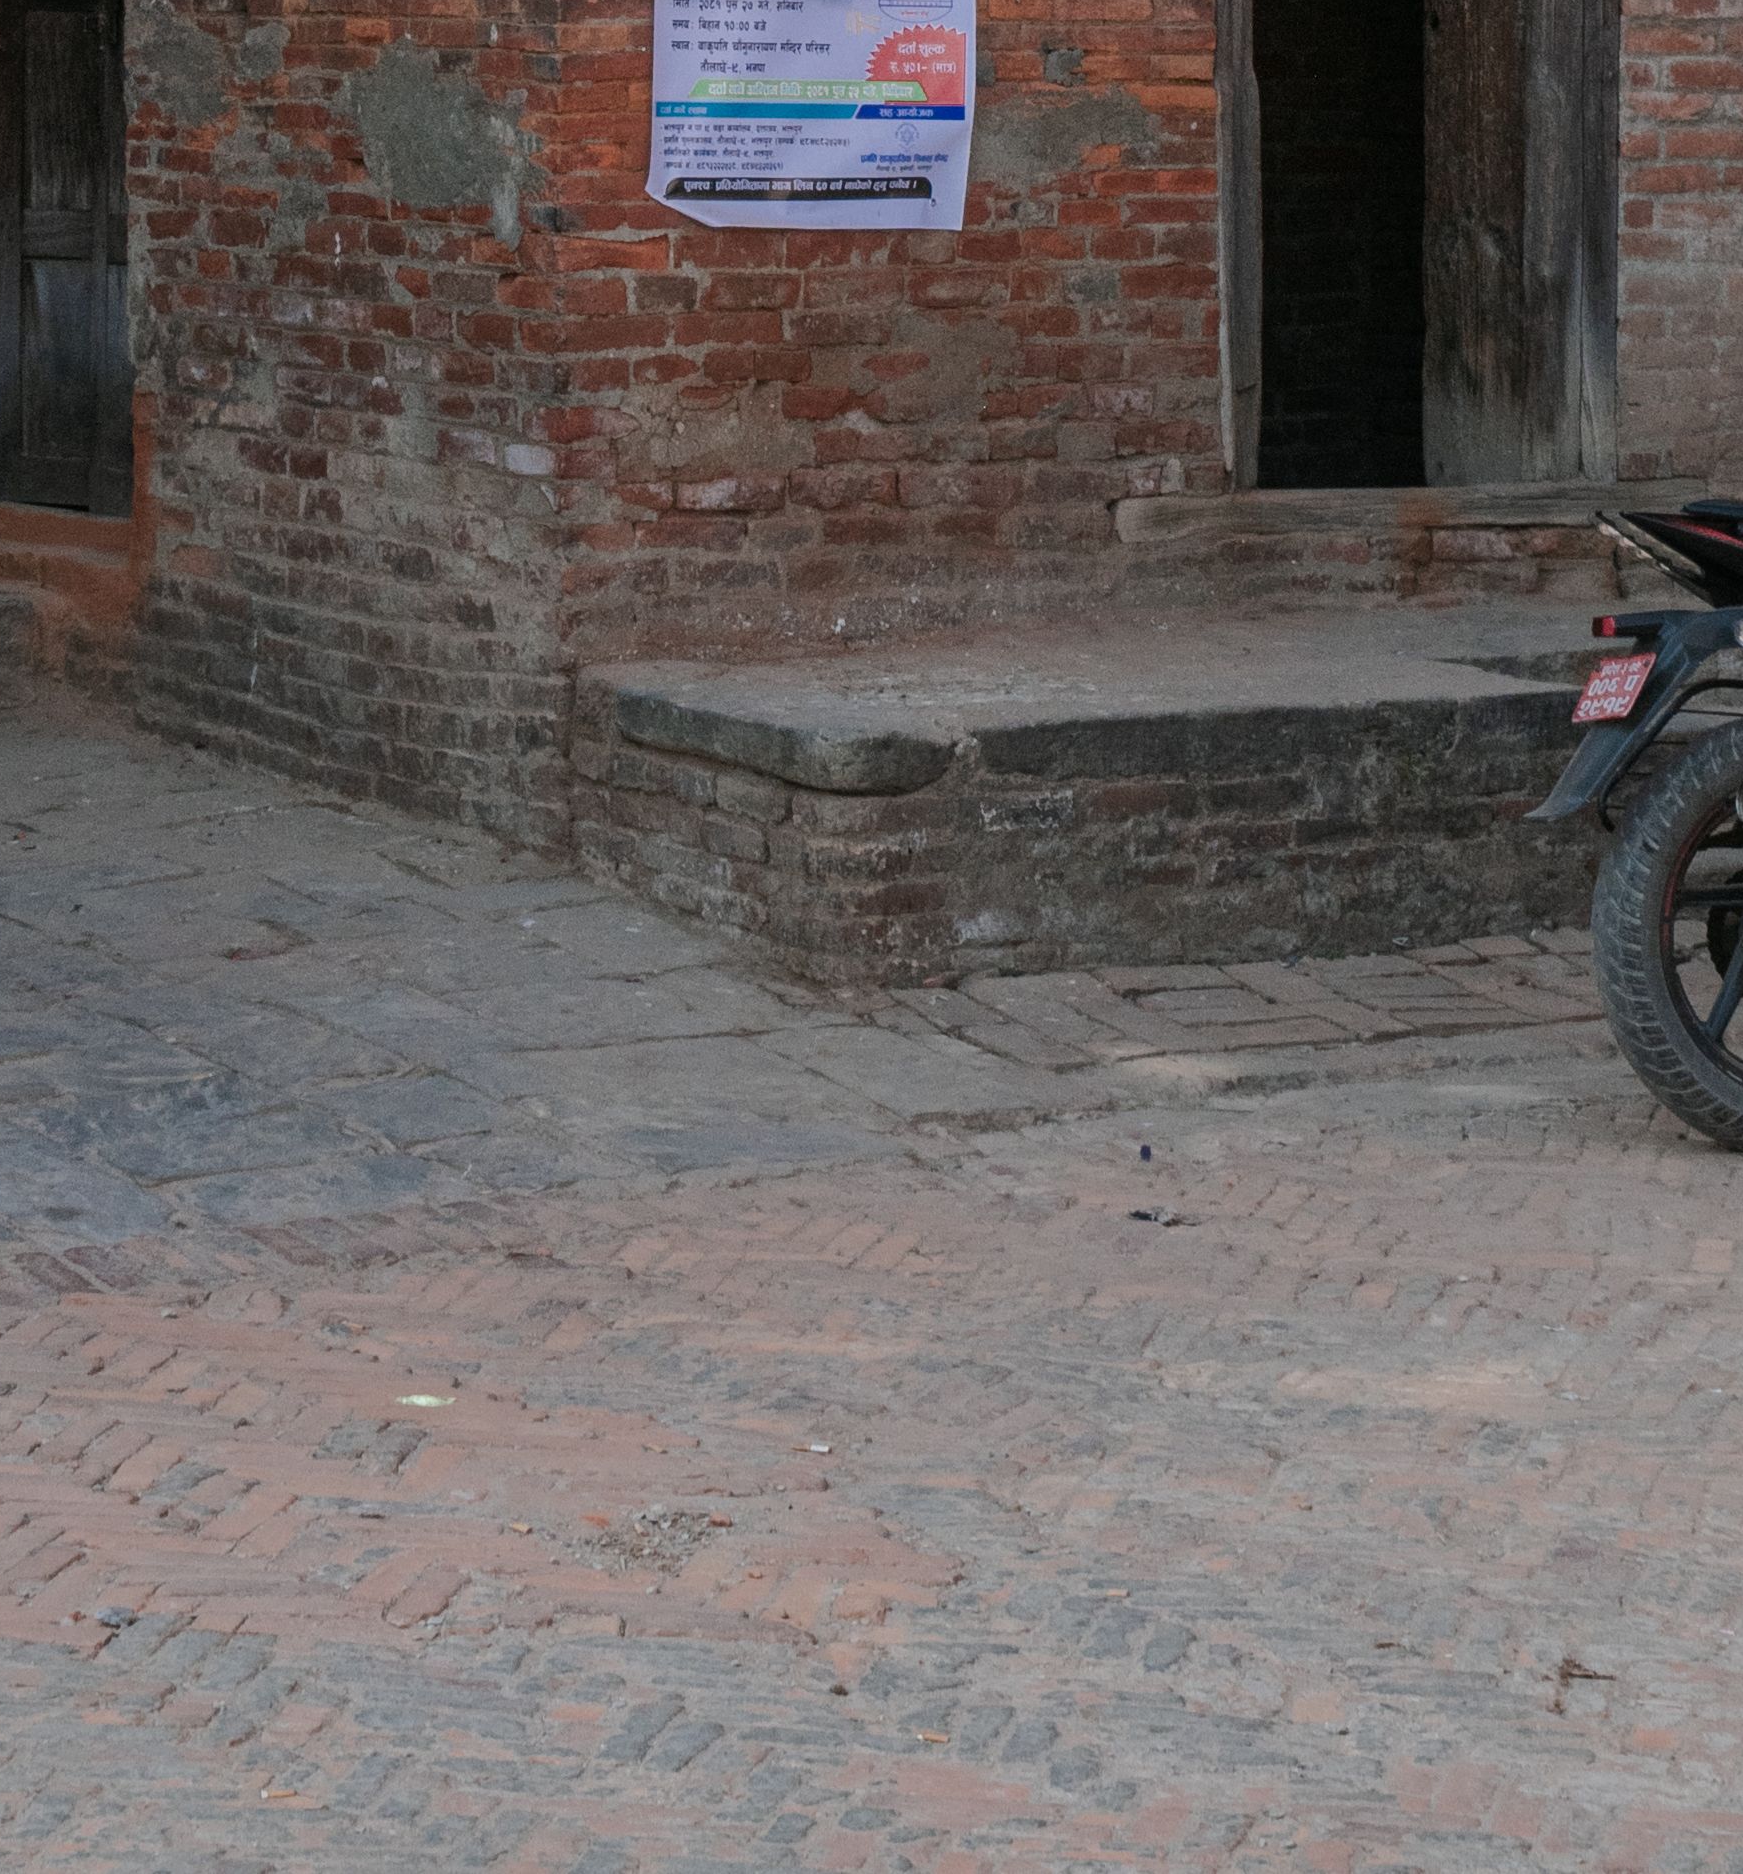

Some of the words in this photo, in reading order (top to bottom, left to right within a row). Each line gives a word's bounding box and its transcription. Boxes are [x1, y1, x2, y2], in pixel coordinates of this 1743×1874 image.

[698, 0, 721, 11] २०८१
[726, 0, 737, 13] पुस
[741, 2, 753, 13] २७
[698, 16, 720, 30] बिहान
[753, 18, 766, 31] बजे
[697, 37, 727, 55] वाकुपति
[780, 38, 802, 55] मन्दिर
[805, 39, 830, 55] परिसर
[898, 40, 916, 54] दर्ता
[918, 42, 945, 58] शुल्क
